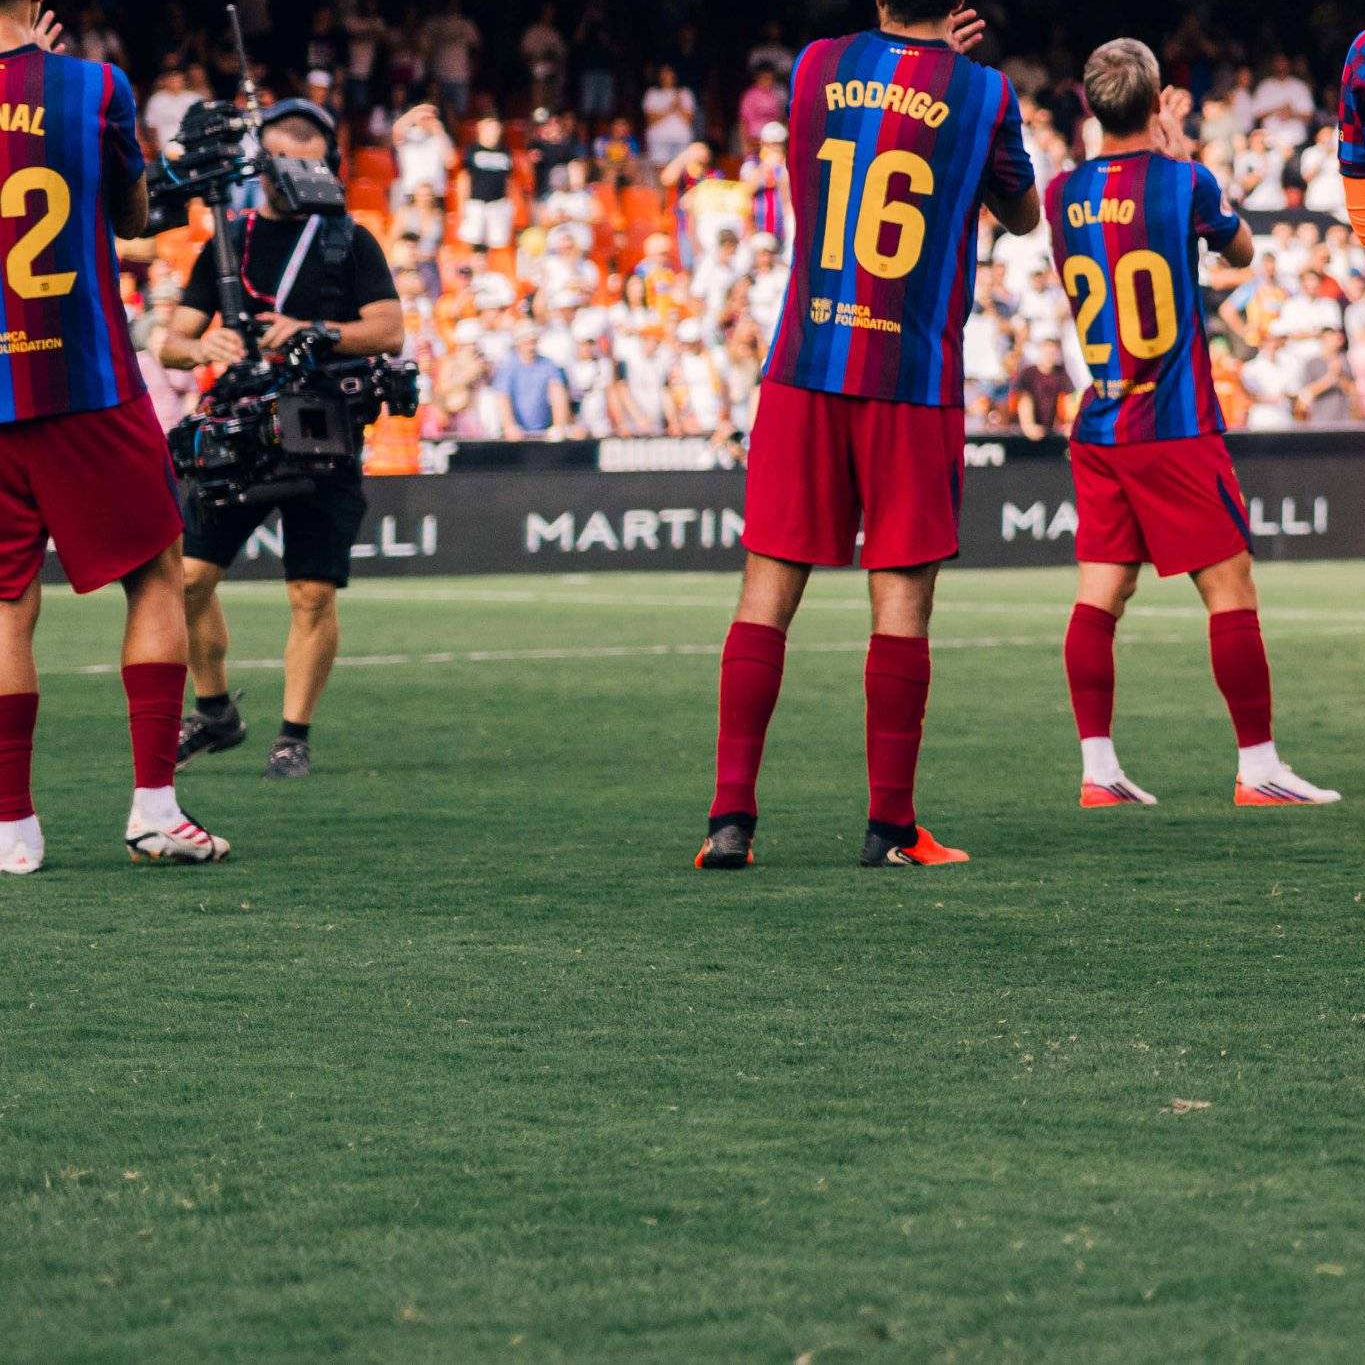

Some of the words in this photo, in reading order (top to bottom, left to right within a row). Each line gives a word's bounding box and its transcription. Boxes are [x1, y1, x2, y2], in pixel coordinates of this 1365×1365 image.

[825, 81, 950, 128] RODRIGO
[816, 137, 934, 280] 16
[1067, 198, 1136, 228] OLMO
[834, 313, 902, 334] FOUNDATION
[1063, 249, 1178, 364] 20
